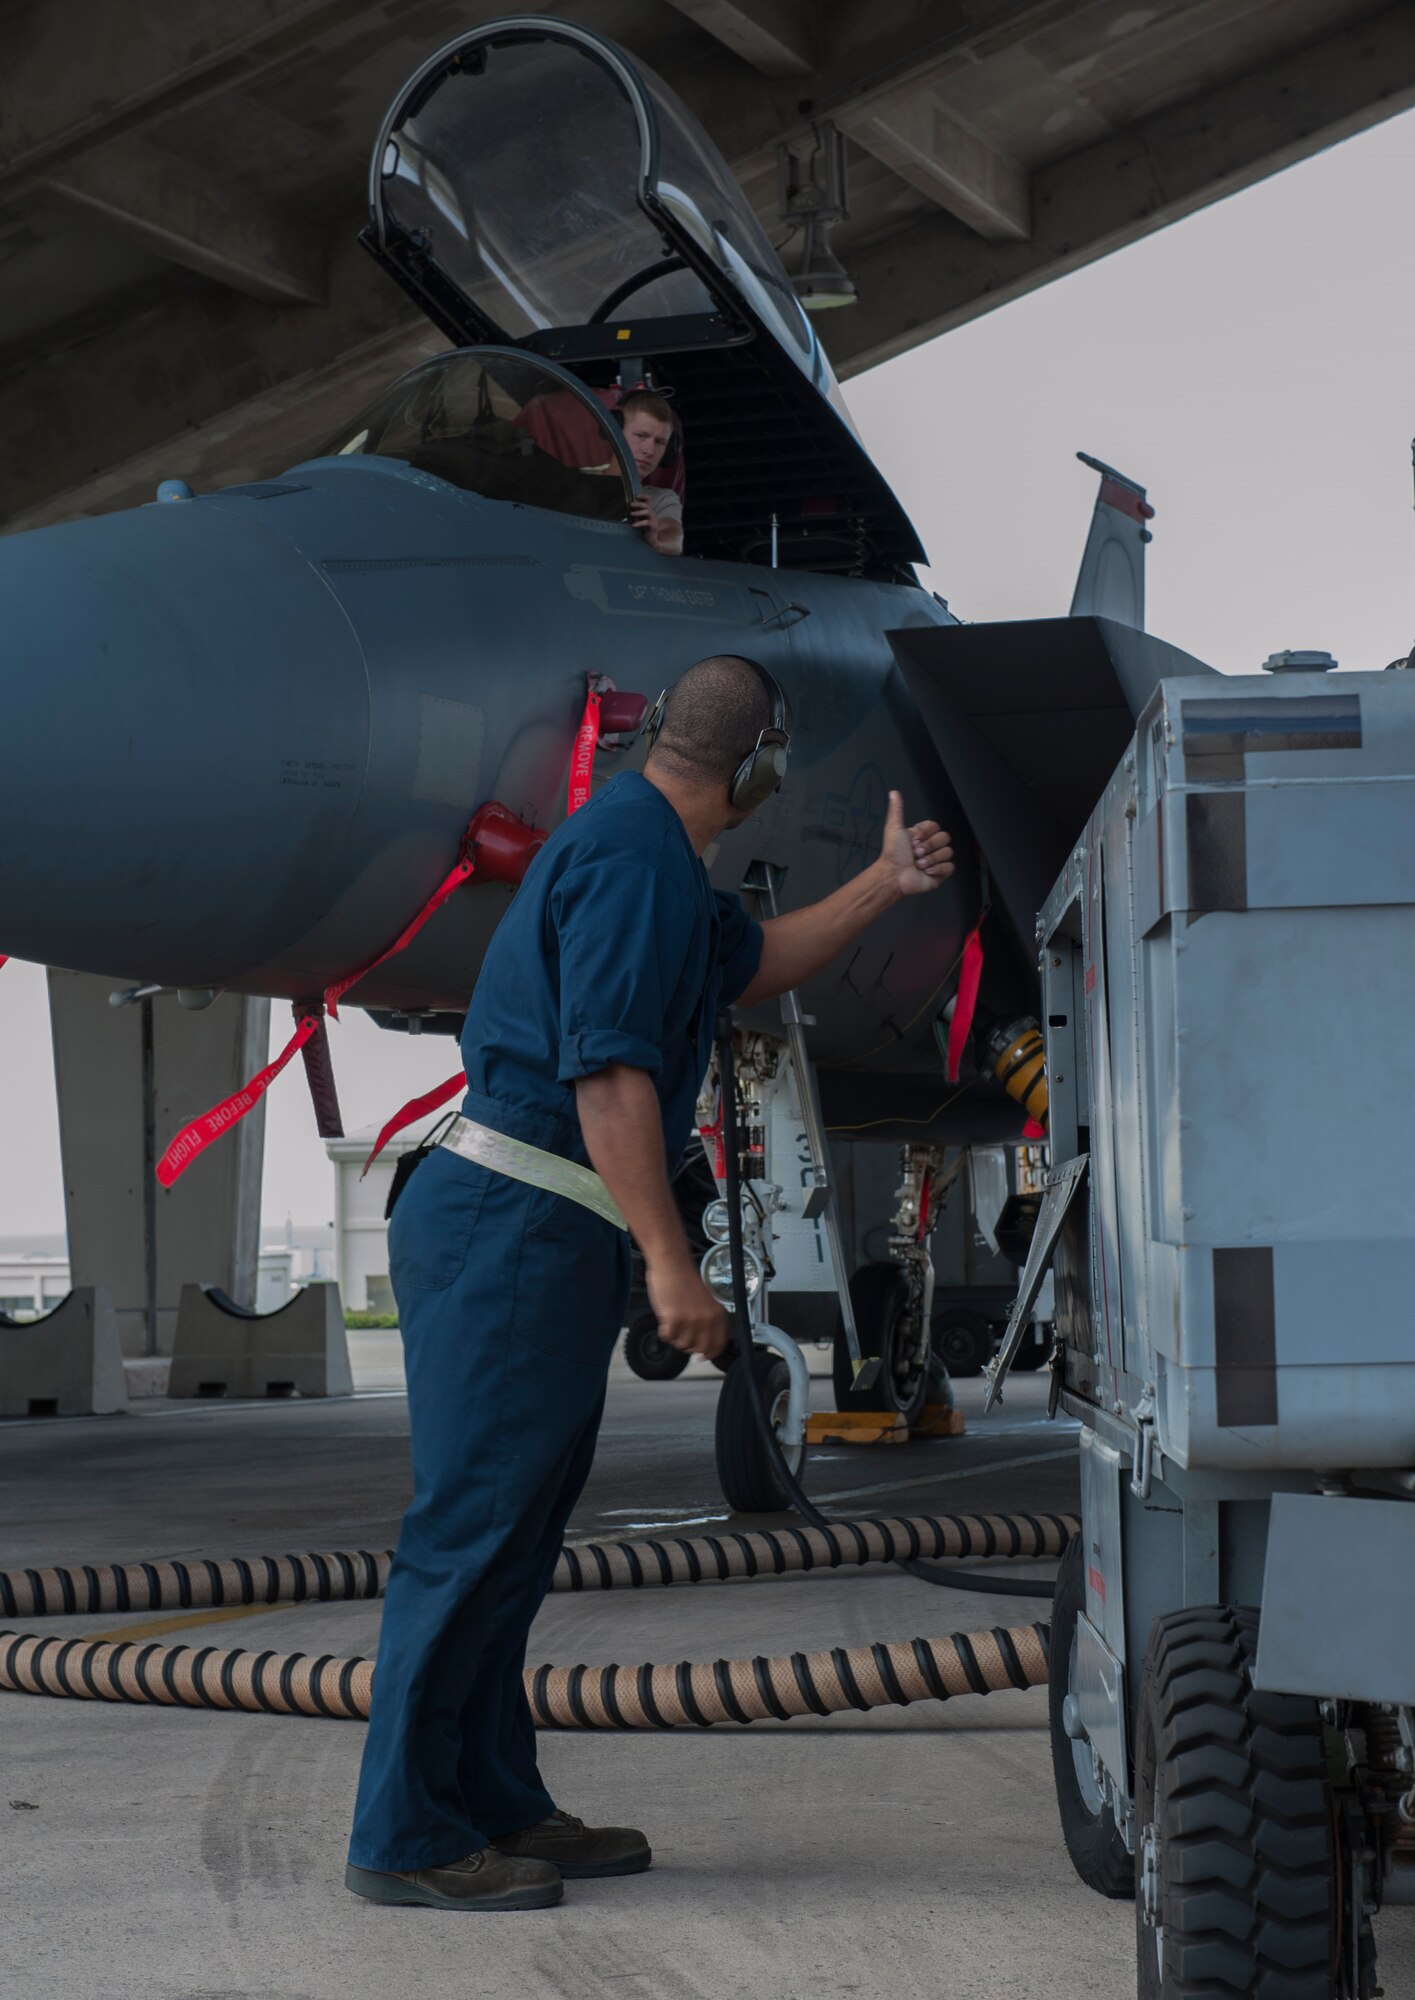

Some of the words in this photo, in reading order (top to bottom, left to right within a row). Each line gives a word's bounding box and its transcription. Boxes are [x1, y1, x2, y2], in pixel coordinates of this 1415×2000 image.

[575, 725, 594, 778] REMOVE
[573, 787, 587, 808] BE
[204, 1093, 253, 1133] BEFORE
[166, 1129, 203, 1171] FLIGHT
